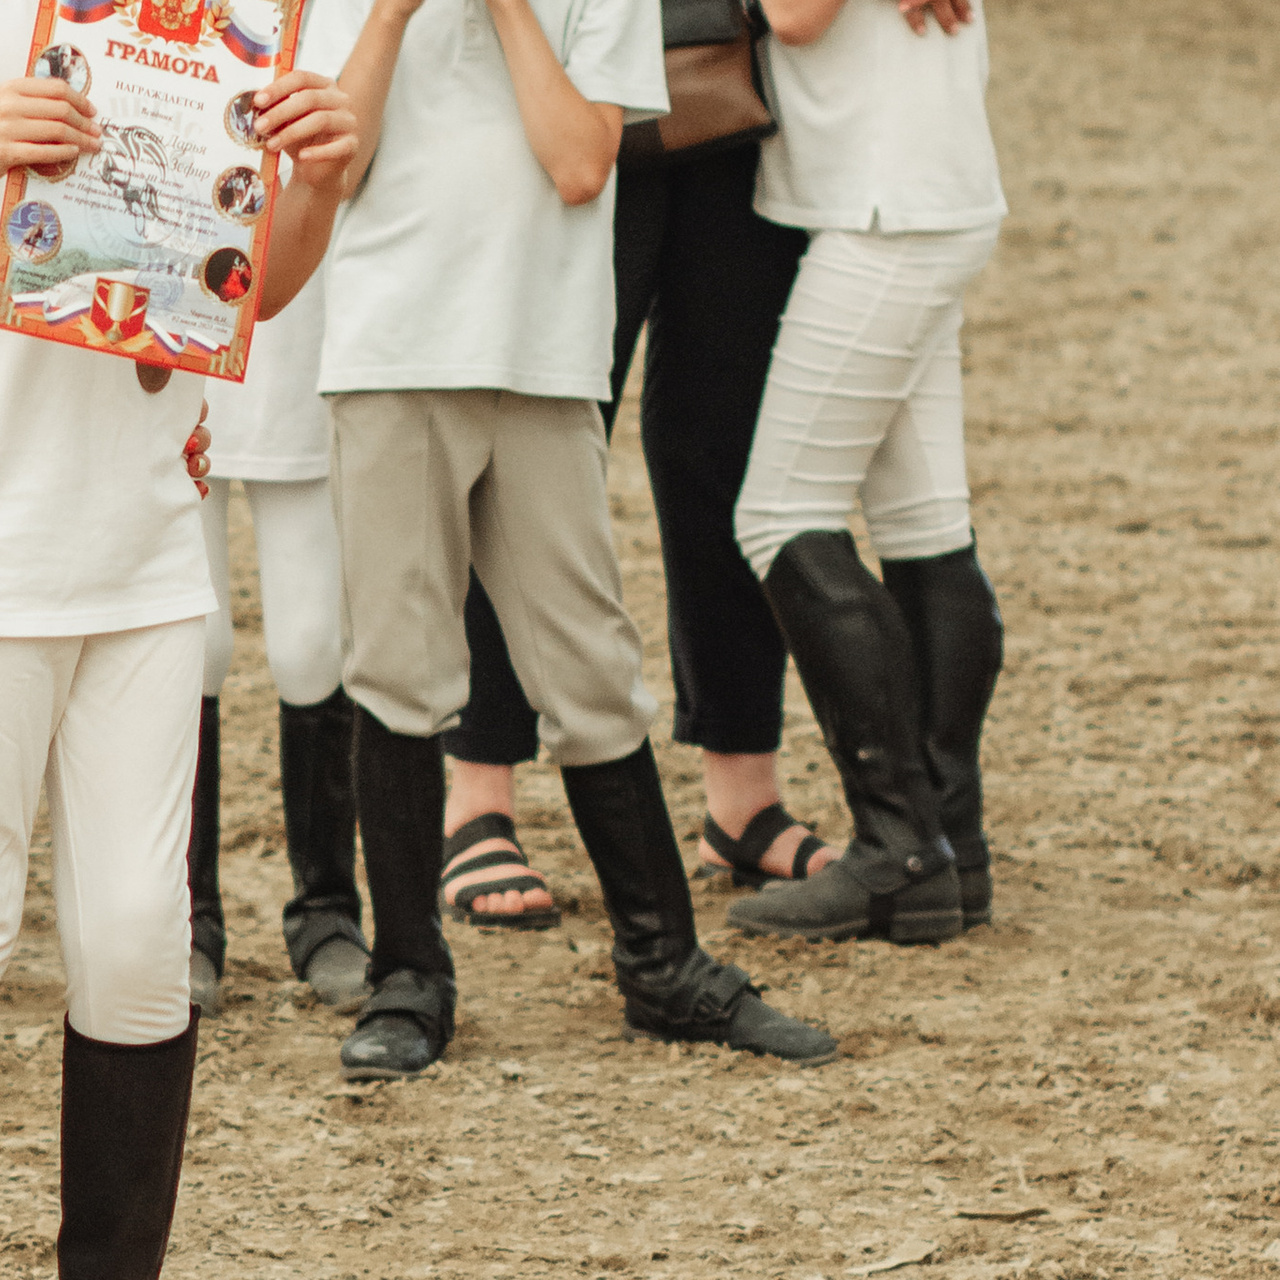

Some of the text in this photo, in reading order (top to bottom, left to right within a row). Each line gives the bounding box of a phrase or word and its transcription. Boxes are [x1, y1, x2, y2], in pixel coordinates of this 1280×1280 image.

[104, 38, 220, 84] ГРАМОТА
[115, 80, 205, 112] НАГРАЖДАЕТСЯ
[170, 156, 211, 182] Зефир
